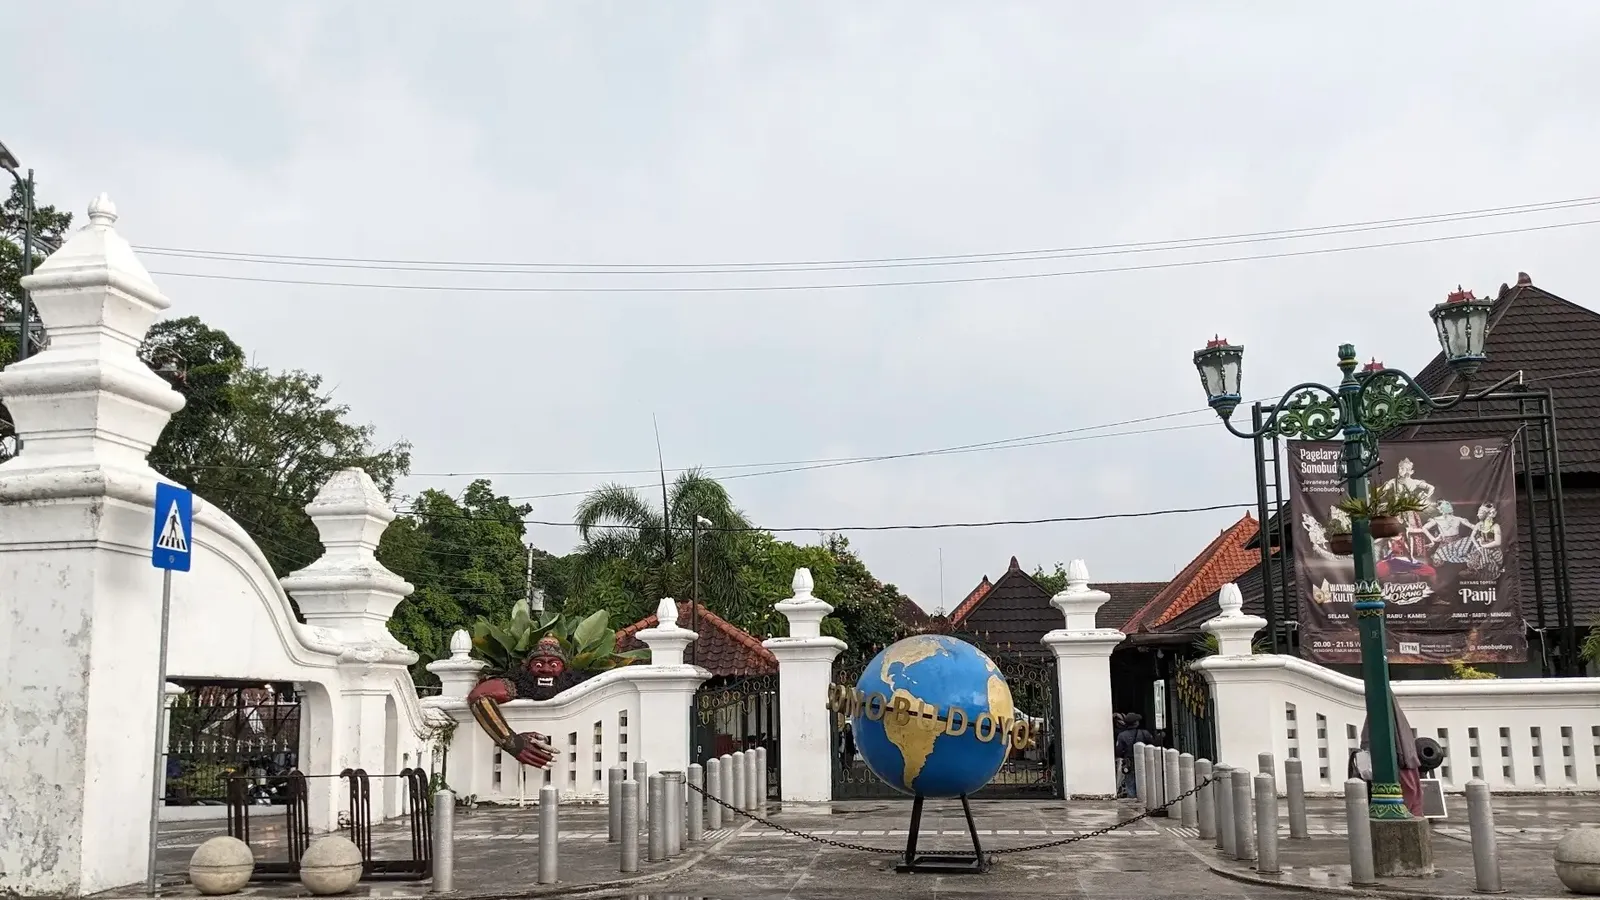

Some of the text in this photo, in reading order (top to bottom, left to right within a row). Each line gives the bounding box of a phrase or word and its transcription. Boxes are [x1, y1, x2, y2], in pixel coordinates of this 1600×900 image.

[1301, 461, 1348, 474] Sonobud
[1329, 583, 1355, 593] WAYANG
[1385, 582, 1425, 594] WAYANG
[1332, 593, 1354, 603] KULIT
[1391, 590, 1422, 602] ORANG
[1458, 587, 1497, 605] Panji
